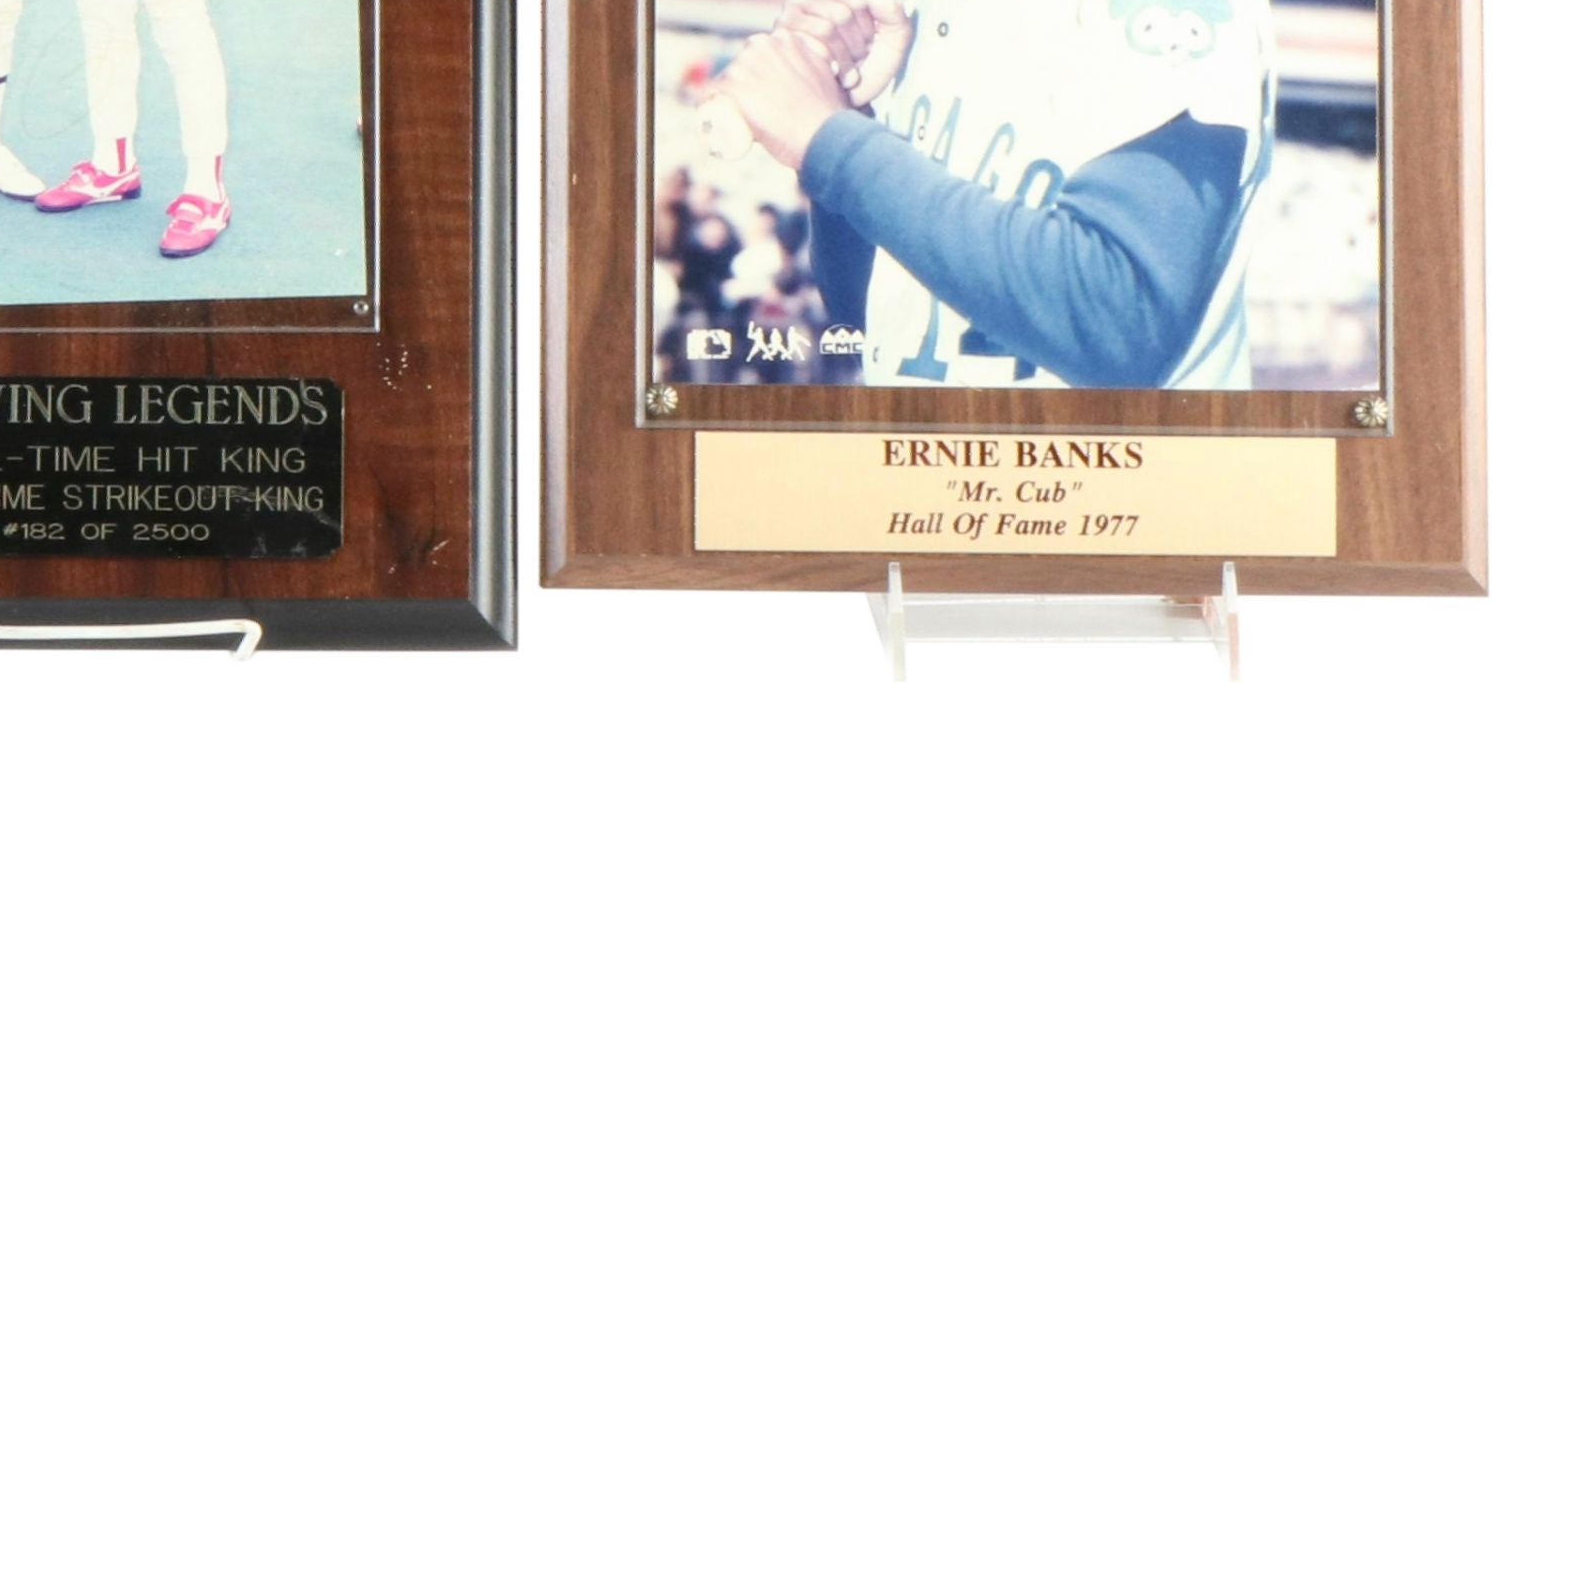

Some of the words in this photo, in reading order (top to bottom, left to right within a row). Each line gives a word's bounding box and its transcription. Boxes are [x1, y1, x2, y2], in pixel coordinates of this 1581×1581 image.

[116, 384, 328, 427] LEGENDS
[138, 446, 198, 472] HIT
[221, 447, 306, 474] KING
[883, 439, 999, 467] ERNIE
[1016, 441, 1143, 469] BANKS
[63, 484, 237, 511] STRIKEOUT
[255, 486, 324, 512] KING
[945, 479, 1003, 503] "Mr.
[1015, 480, 1082, 503] Cub"
[3, 522, 65, 540] #182
[80, 523, 115, 540] OF
[133, 523, 210, 541] 2500
[887, 512, 944, 534] Hall
[952, 512, 989, 540] Of
[995, 513, 1067, 536] Fame
[1080, 514, 1139, 536] 1977
